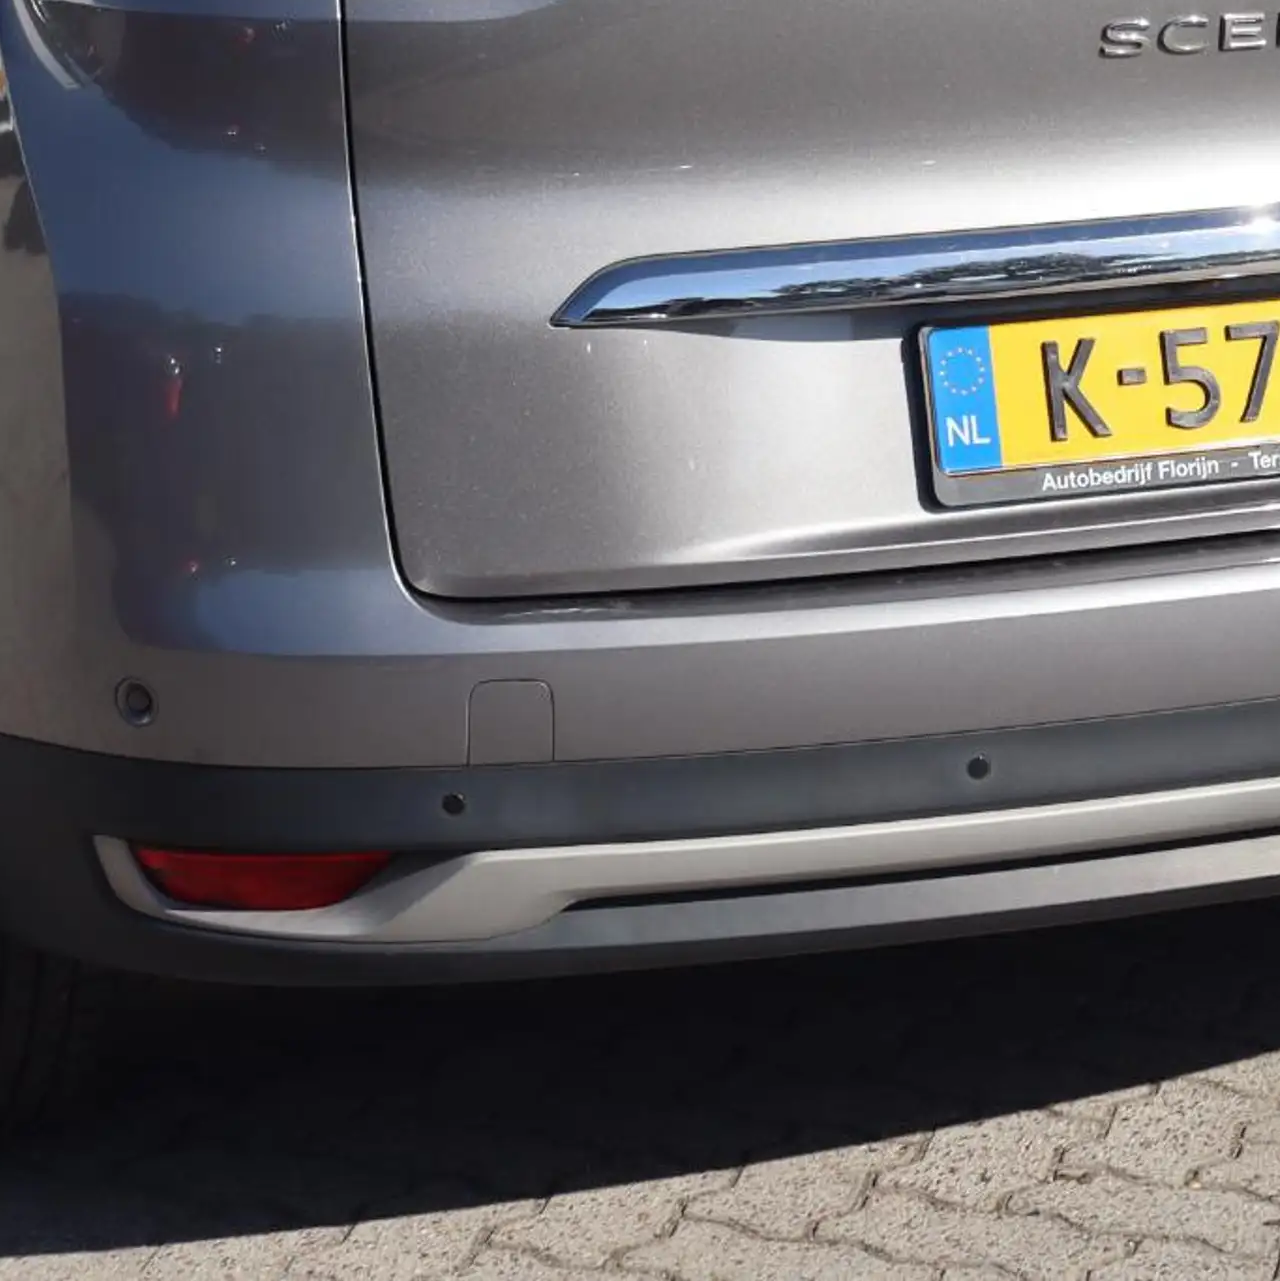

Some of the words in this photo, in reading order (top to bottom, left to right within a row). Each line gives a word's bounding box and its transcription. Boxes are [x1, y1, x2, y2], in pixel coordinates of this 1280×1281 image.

[946, 413, 991, 448] NL
[1041, 466, 1153, 492] Autobedrijf
[1158, 456, 1220, 481] Florijn
